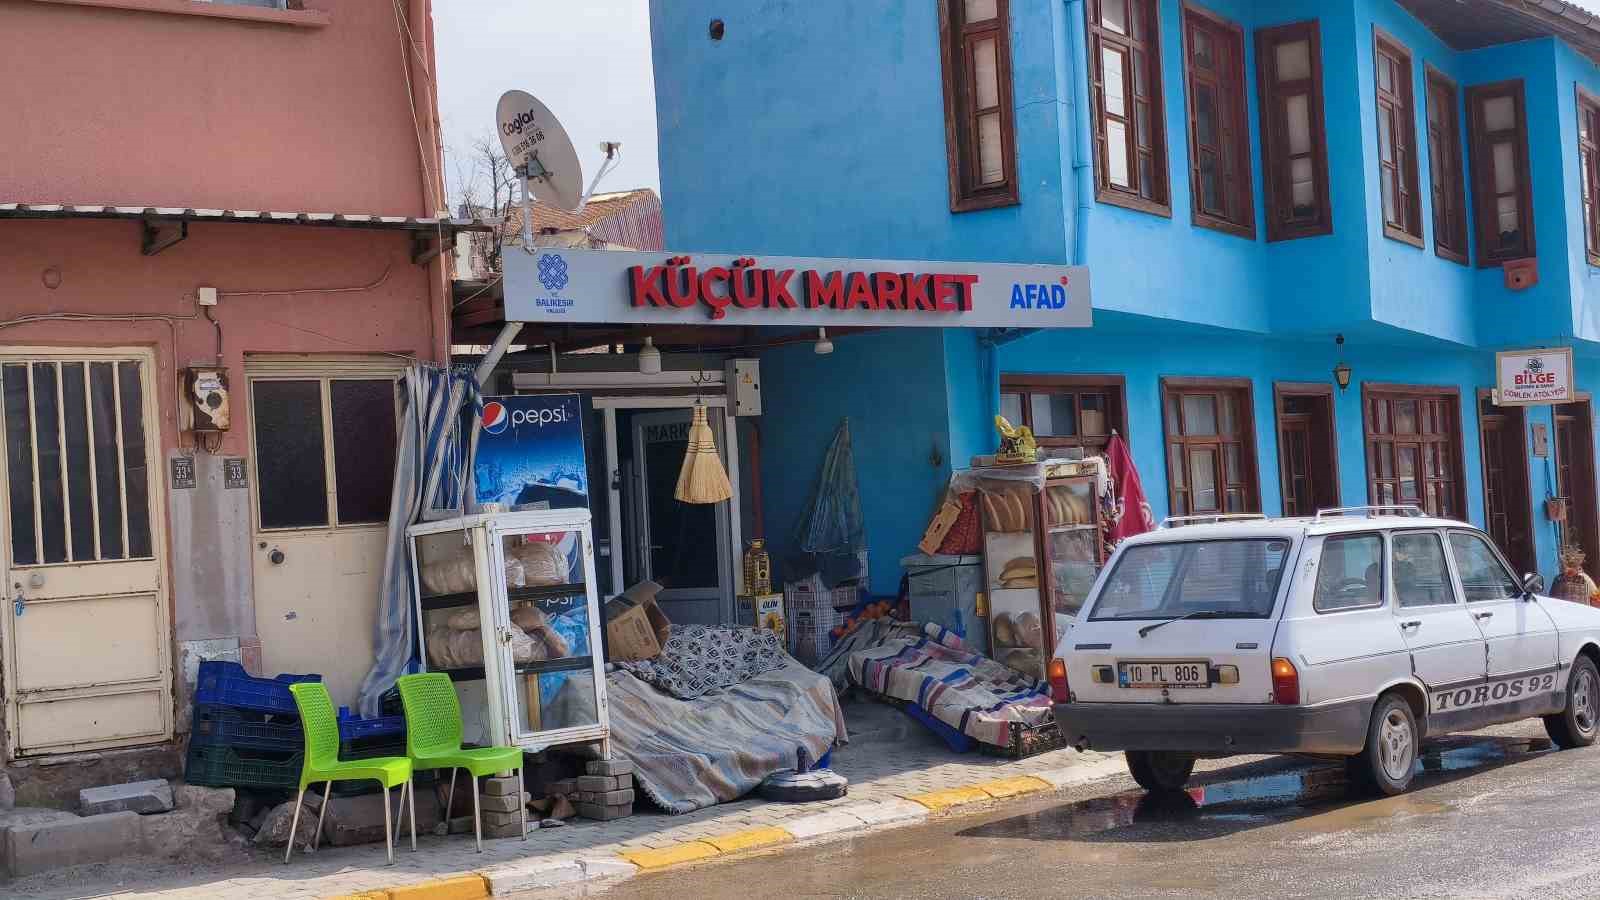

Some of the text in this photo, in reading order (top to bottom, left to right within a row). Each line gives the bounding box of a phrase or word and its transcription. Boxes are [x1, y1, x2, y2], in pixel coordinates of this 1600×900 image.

[629, 255, 979, 320] KÜÇÜK MARKET
[1009, 282, 1067, 309] AFAD
[1514, 370, 1555, 385] BİLGE
[512, 404, 568, 428] pepsi
[1130, 665, 1200, 682] 10 PL 806
[1436, 674, 1554, 711] TOROS 92
